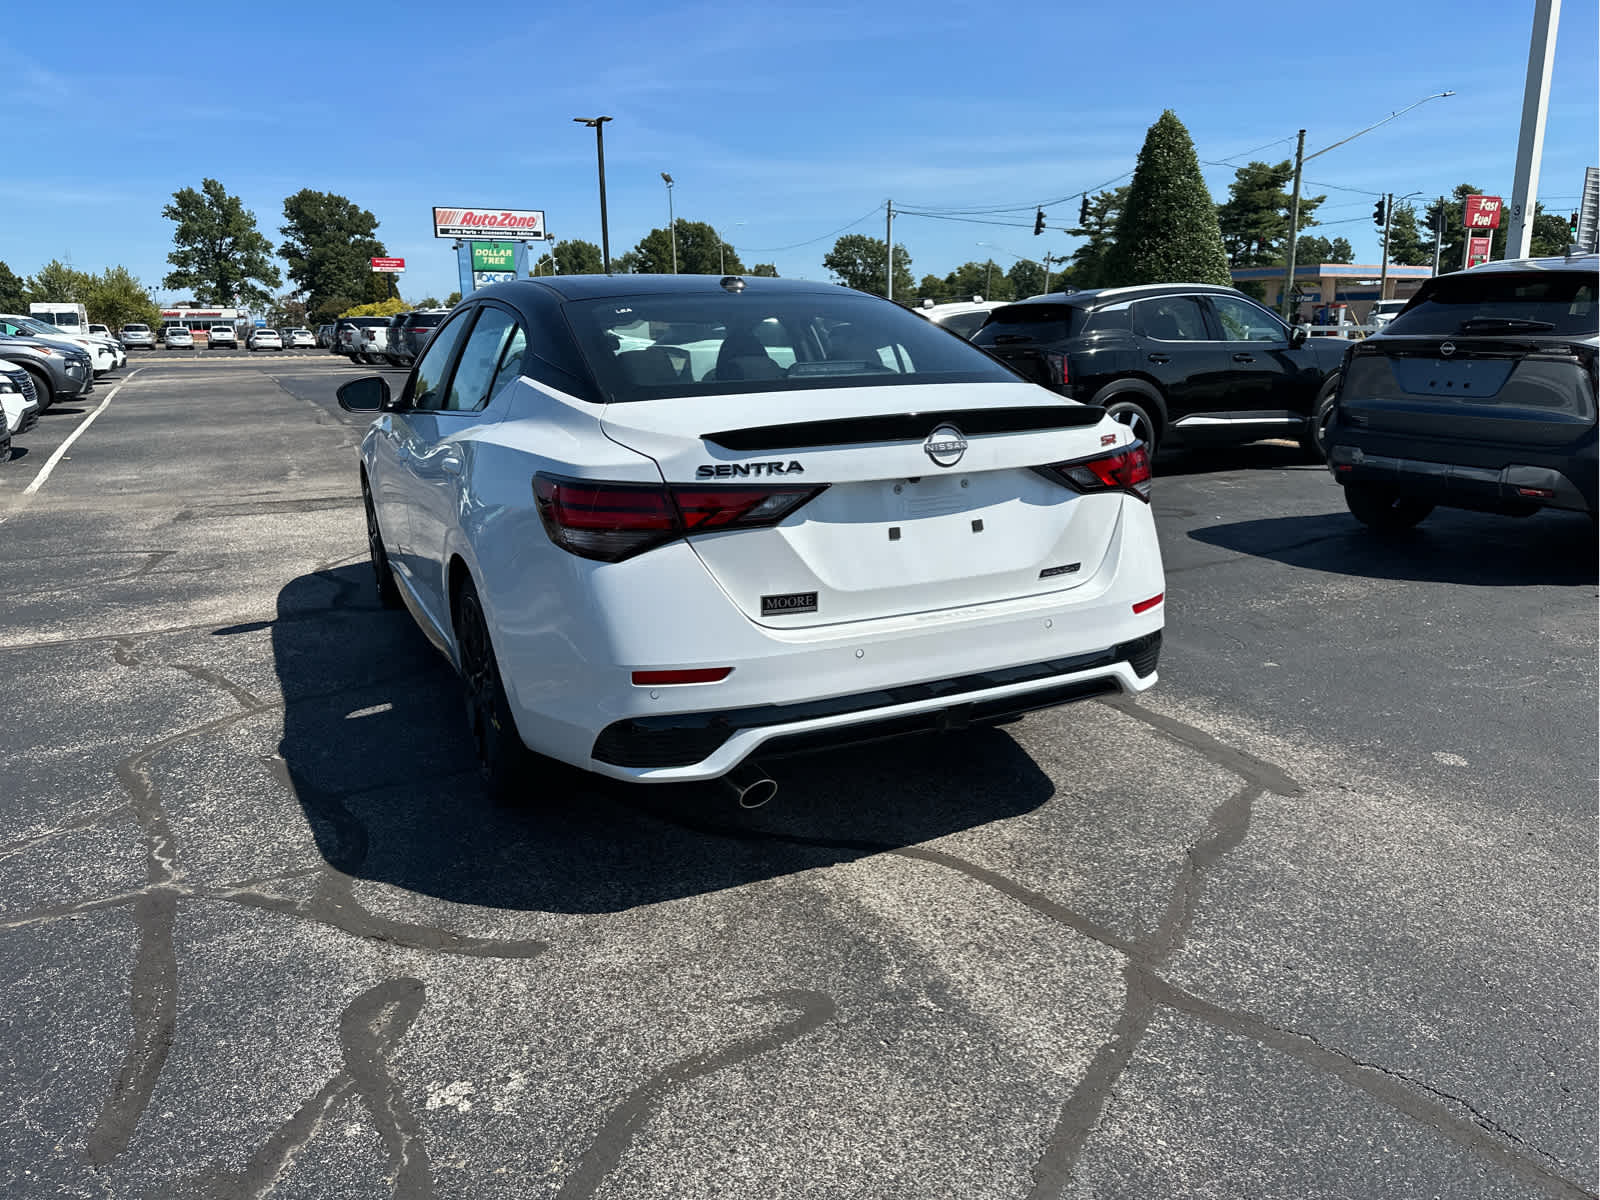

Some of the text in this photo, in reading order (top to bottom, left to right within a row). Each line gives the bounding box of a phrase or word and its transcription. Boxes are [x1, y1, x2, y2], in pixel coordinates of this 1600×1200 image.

[1480, 199, 1499, 211] Fast
[460, 211, 537, 229] AutoZone
[1472, 213, 1493, 226] Fuel
[475, 249, 512, 257] DOLLAR
[482, 257, 506, 265] TREE
[925, 441, 968, 451] NISSAN
[697, 460, 805, 477] SENTRA
[767, 595, 814, 609] MOORE
